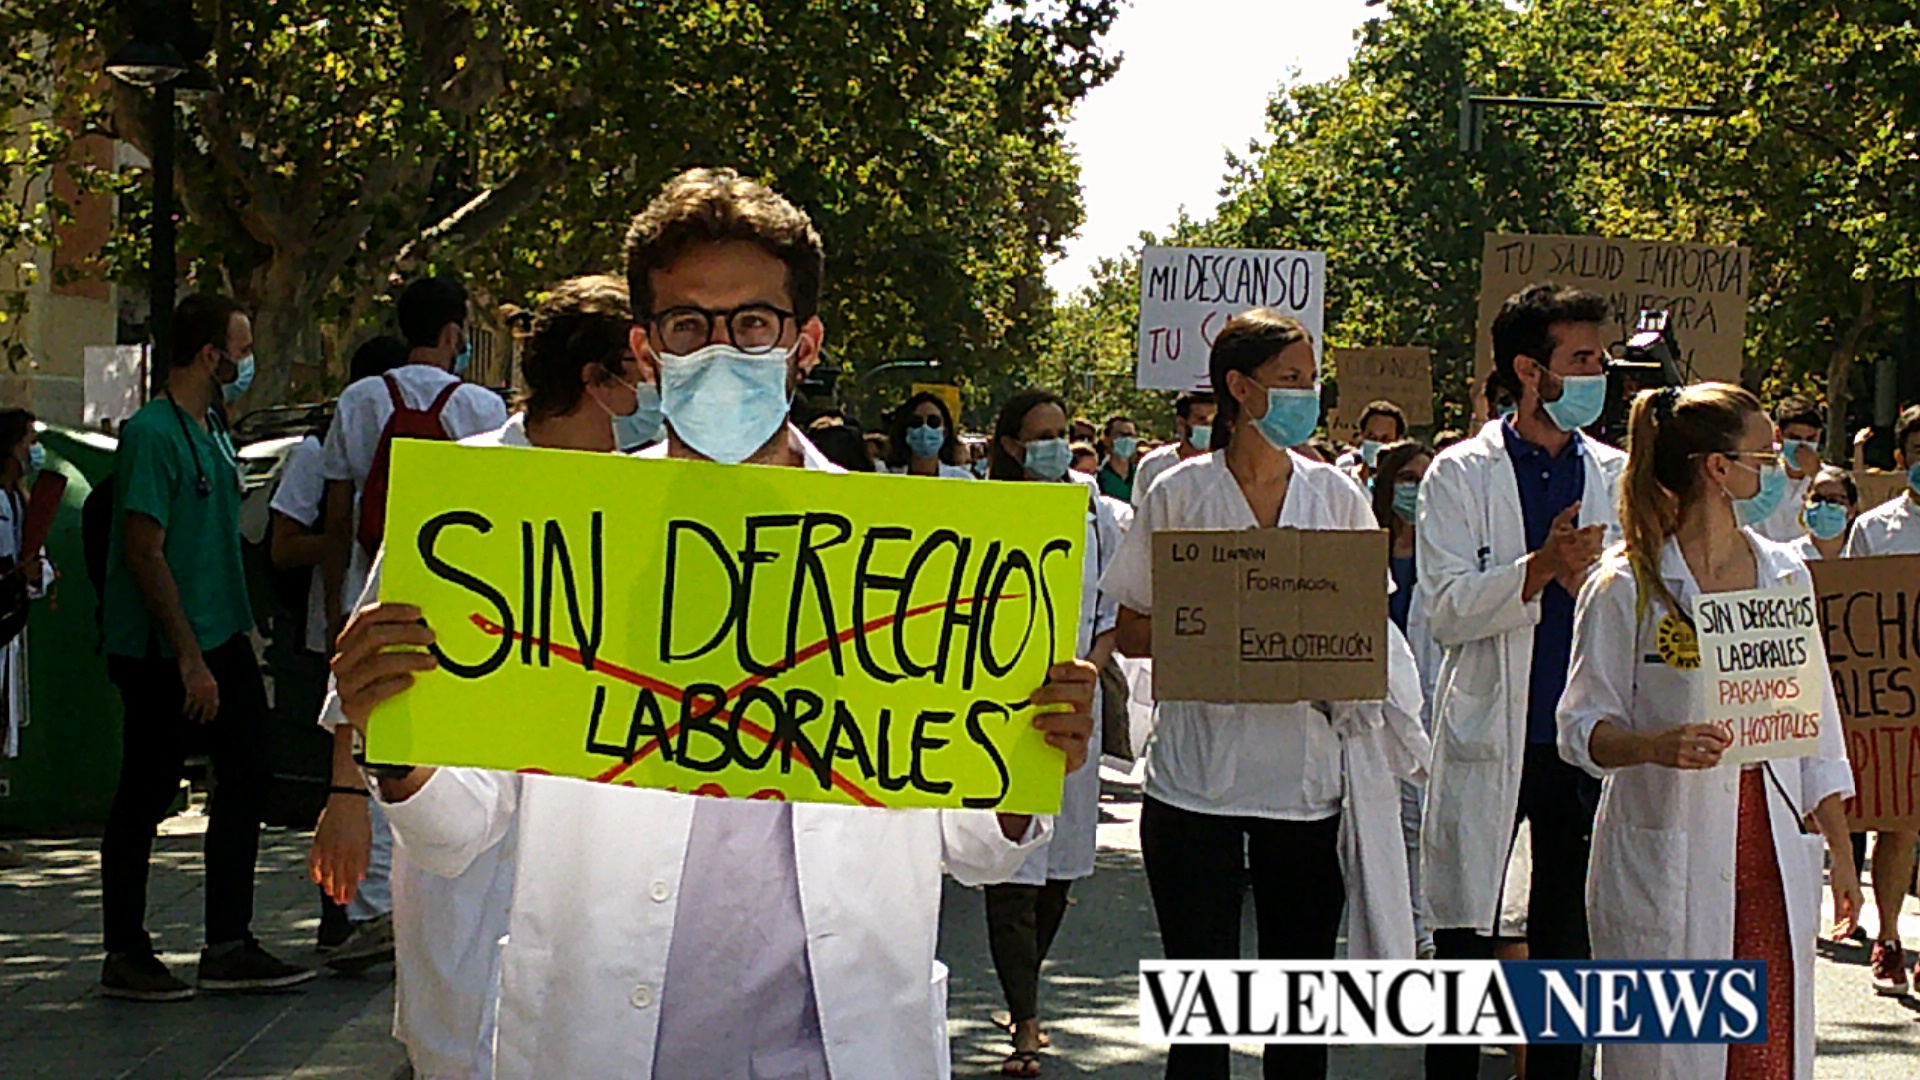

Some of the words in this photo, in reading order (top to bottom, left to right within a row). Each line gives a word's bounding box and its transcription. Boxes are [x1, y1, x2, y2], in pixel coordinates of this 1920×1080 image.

[1497, 242, 1535, 275] TU
[1549, 243, 1625, 281] SALUD
[1184, 254, 1310, 310] DESCANSO
[1148, 327, 1181, 363] TU
[1172, 543, 1200, 562] LO
[417, 511, 603, 679] SIN
[659, 512, 1072, 691] DERECHOS
[1700, 600, 1735, 634] SIN
[1738, 597, 1814, 631] DERECHOS
[1175, 607, 1206, 635] ES
[1241, 628, 1373, 657] EXPLOTACIÓN
[1716, 638, 1806, 672] LABORALES
[1719, 676, 1800, 705] PARAMOS
[586, 683, 1028, 808] LABORALES
[1740, 709, 1819, 747] HOSPITALES
